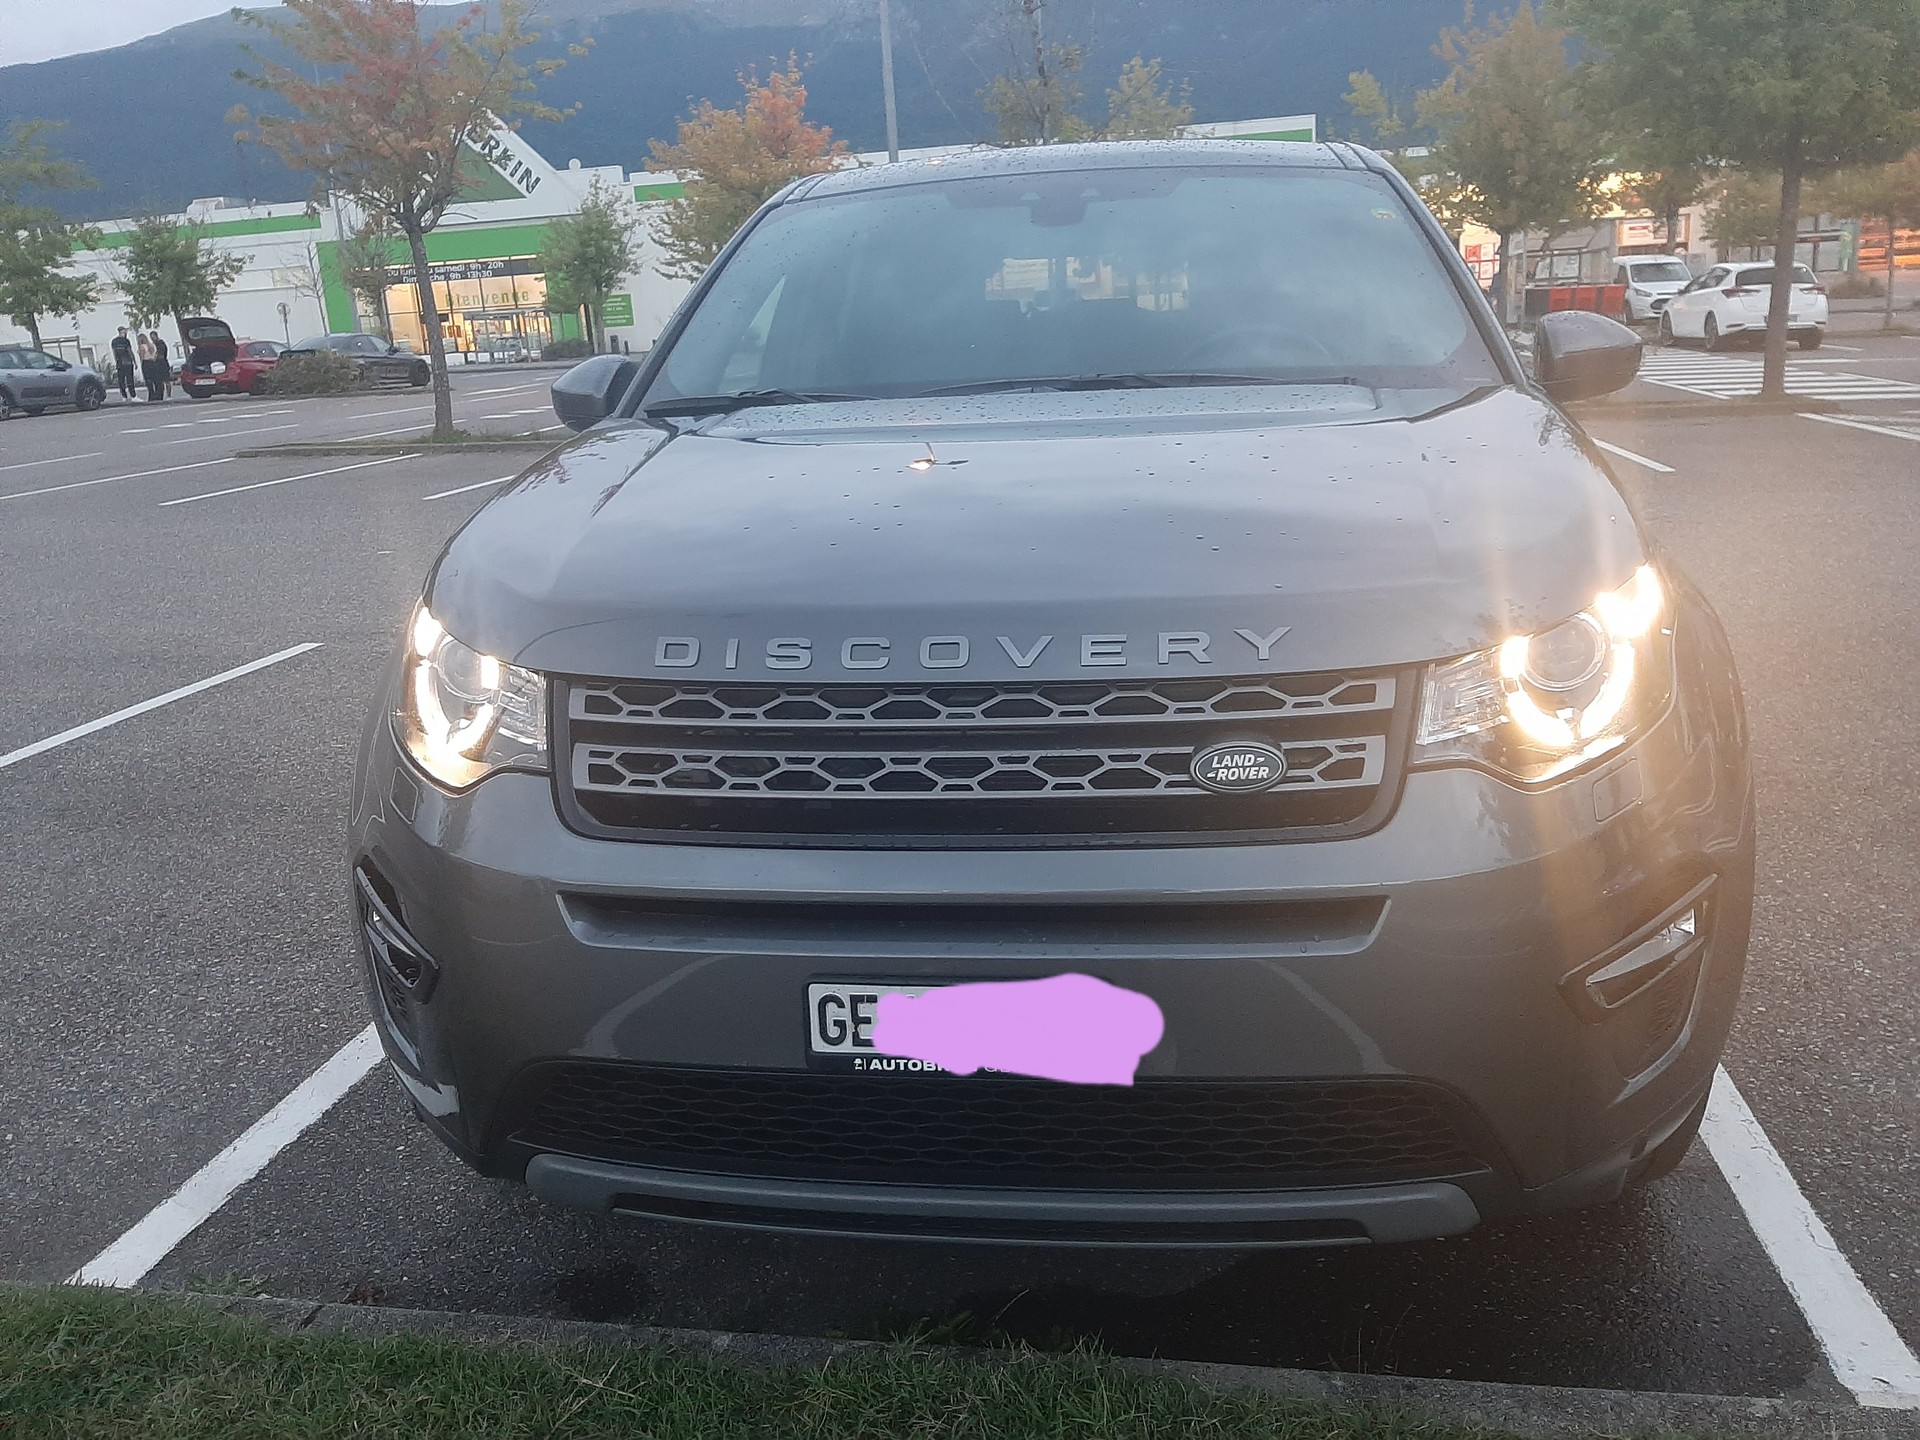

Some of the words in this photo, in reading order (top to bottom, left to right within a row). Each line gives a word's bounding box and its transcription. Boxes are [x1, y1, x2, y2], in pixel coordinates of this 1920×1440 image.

[434, 264, 465, 273] samedi
[469, 262, 481, 270] 9h
[487, 261, 504, 269] 20h
[403, 273, 445, 283] Dimche
[450, 272, 461, 280] 9h
[467, 271, 493, 279] 13h30
[654, 626, 1292, 670] DISCOVERY
[1211, 754, 1255, 768] LAND
[1216, 766, 1270, 781] ROVER
[817, 993, 878, 1047] GE
